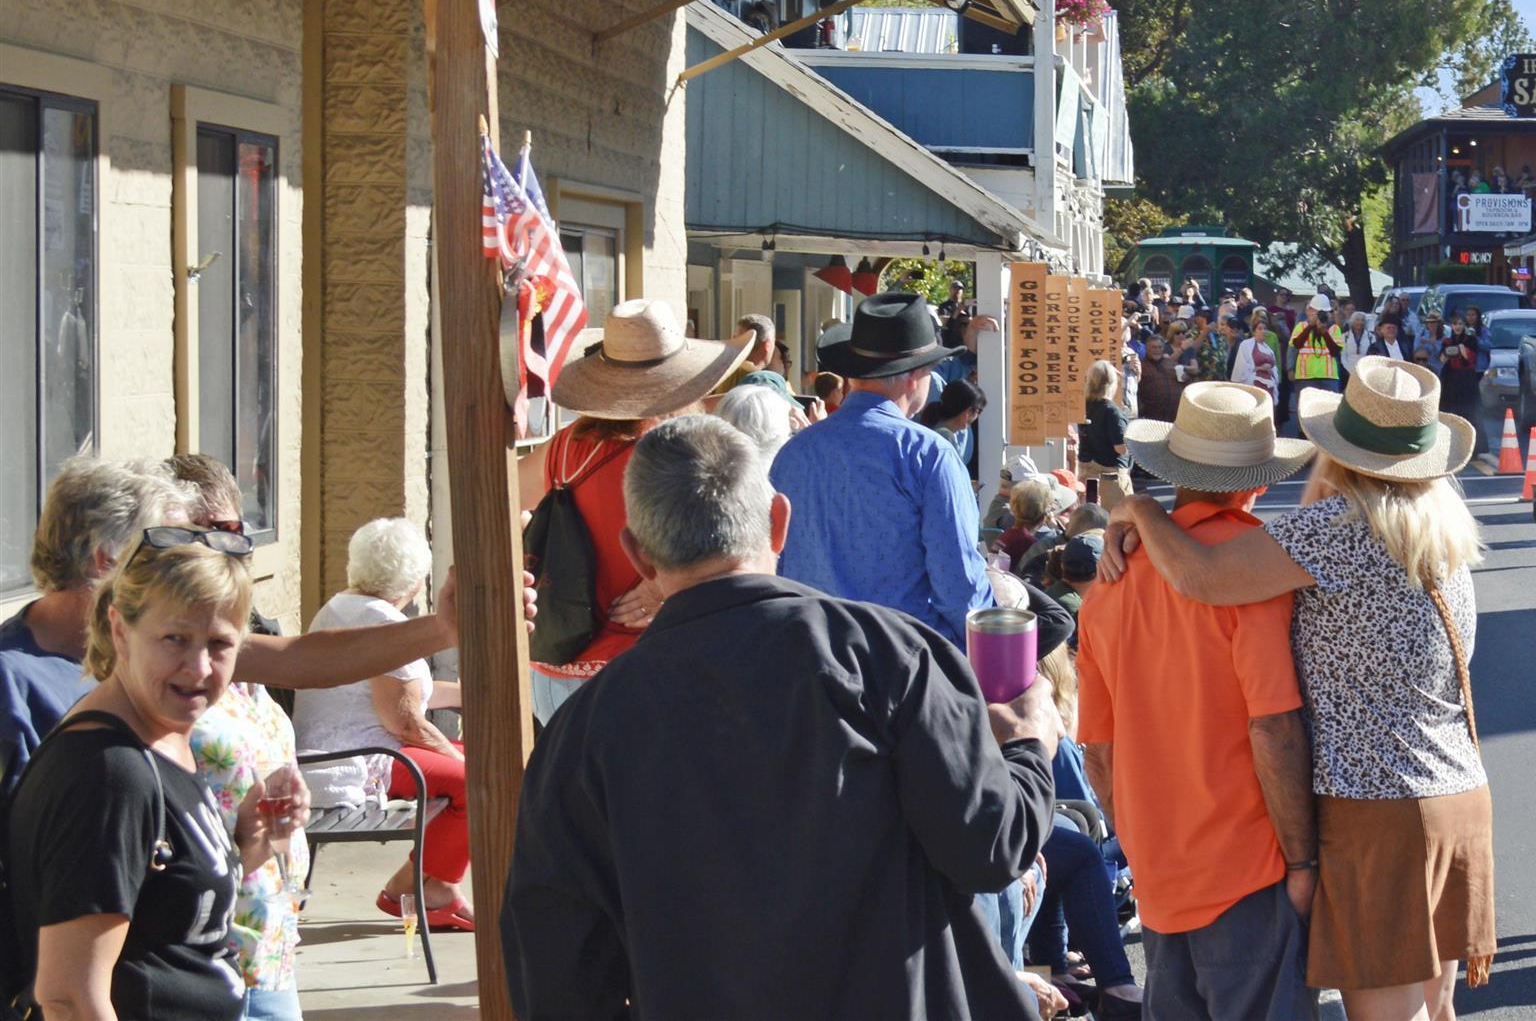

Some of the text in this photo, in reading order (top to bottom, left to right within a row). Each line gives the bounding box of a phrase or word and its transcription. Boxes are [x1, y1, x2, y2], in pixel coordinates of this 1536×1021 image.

[1475, 198, 1529, 208] PROVISIONS
[1019, 280, 1038, 339] GREAT
[1046, 292, 1061, 344] CRAFT
[1089, 301, 1103, 343] LOCAL
[1067, 296, 1080, 382] COCKTAILS
[1018, 348, 1038, 395] FOOD
[1046, 352, 1061, 393] BEER
